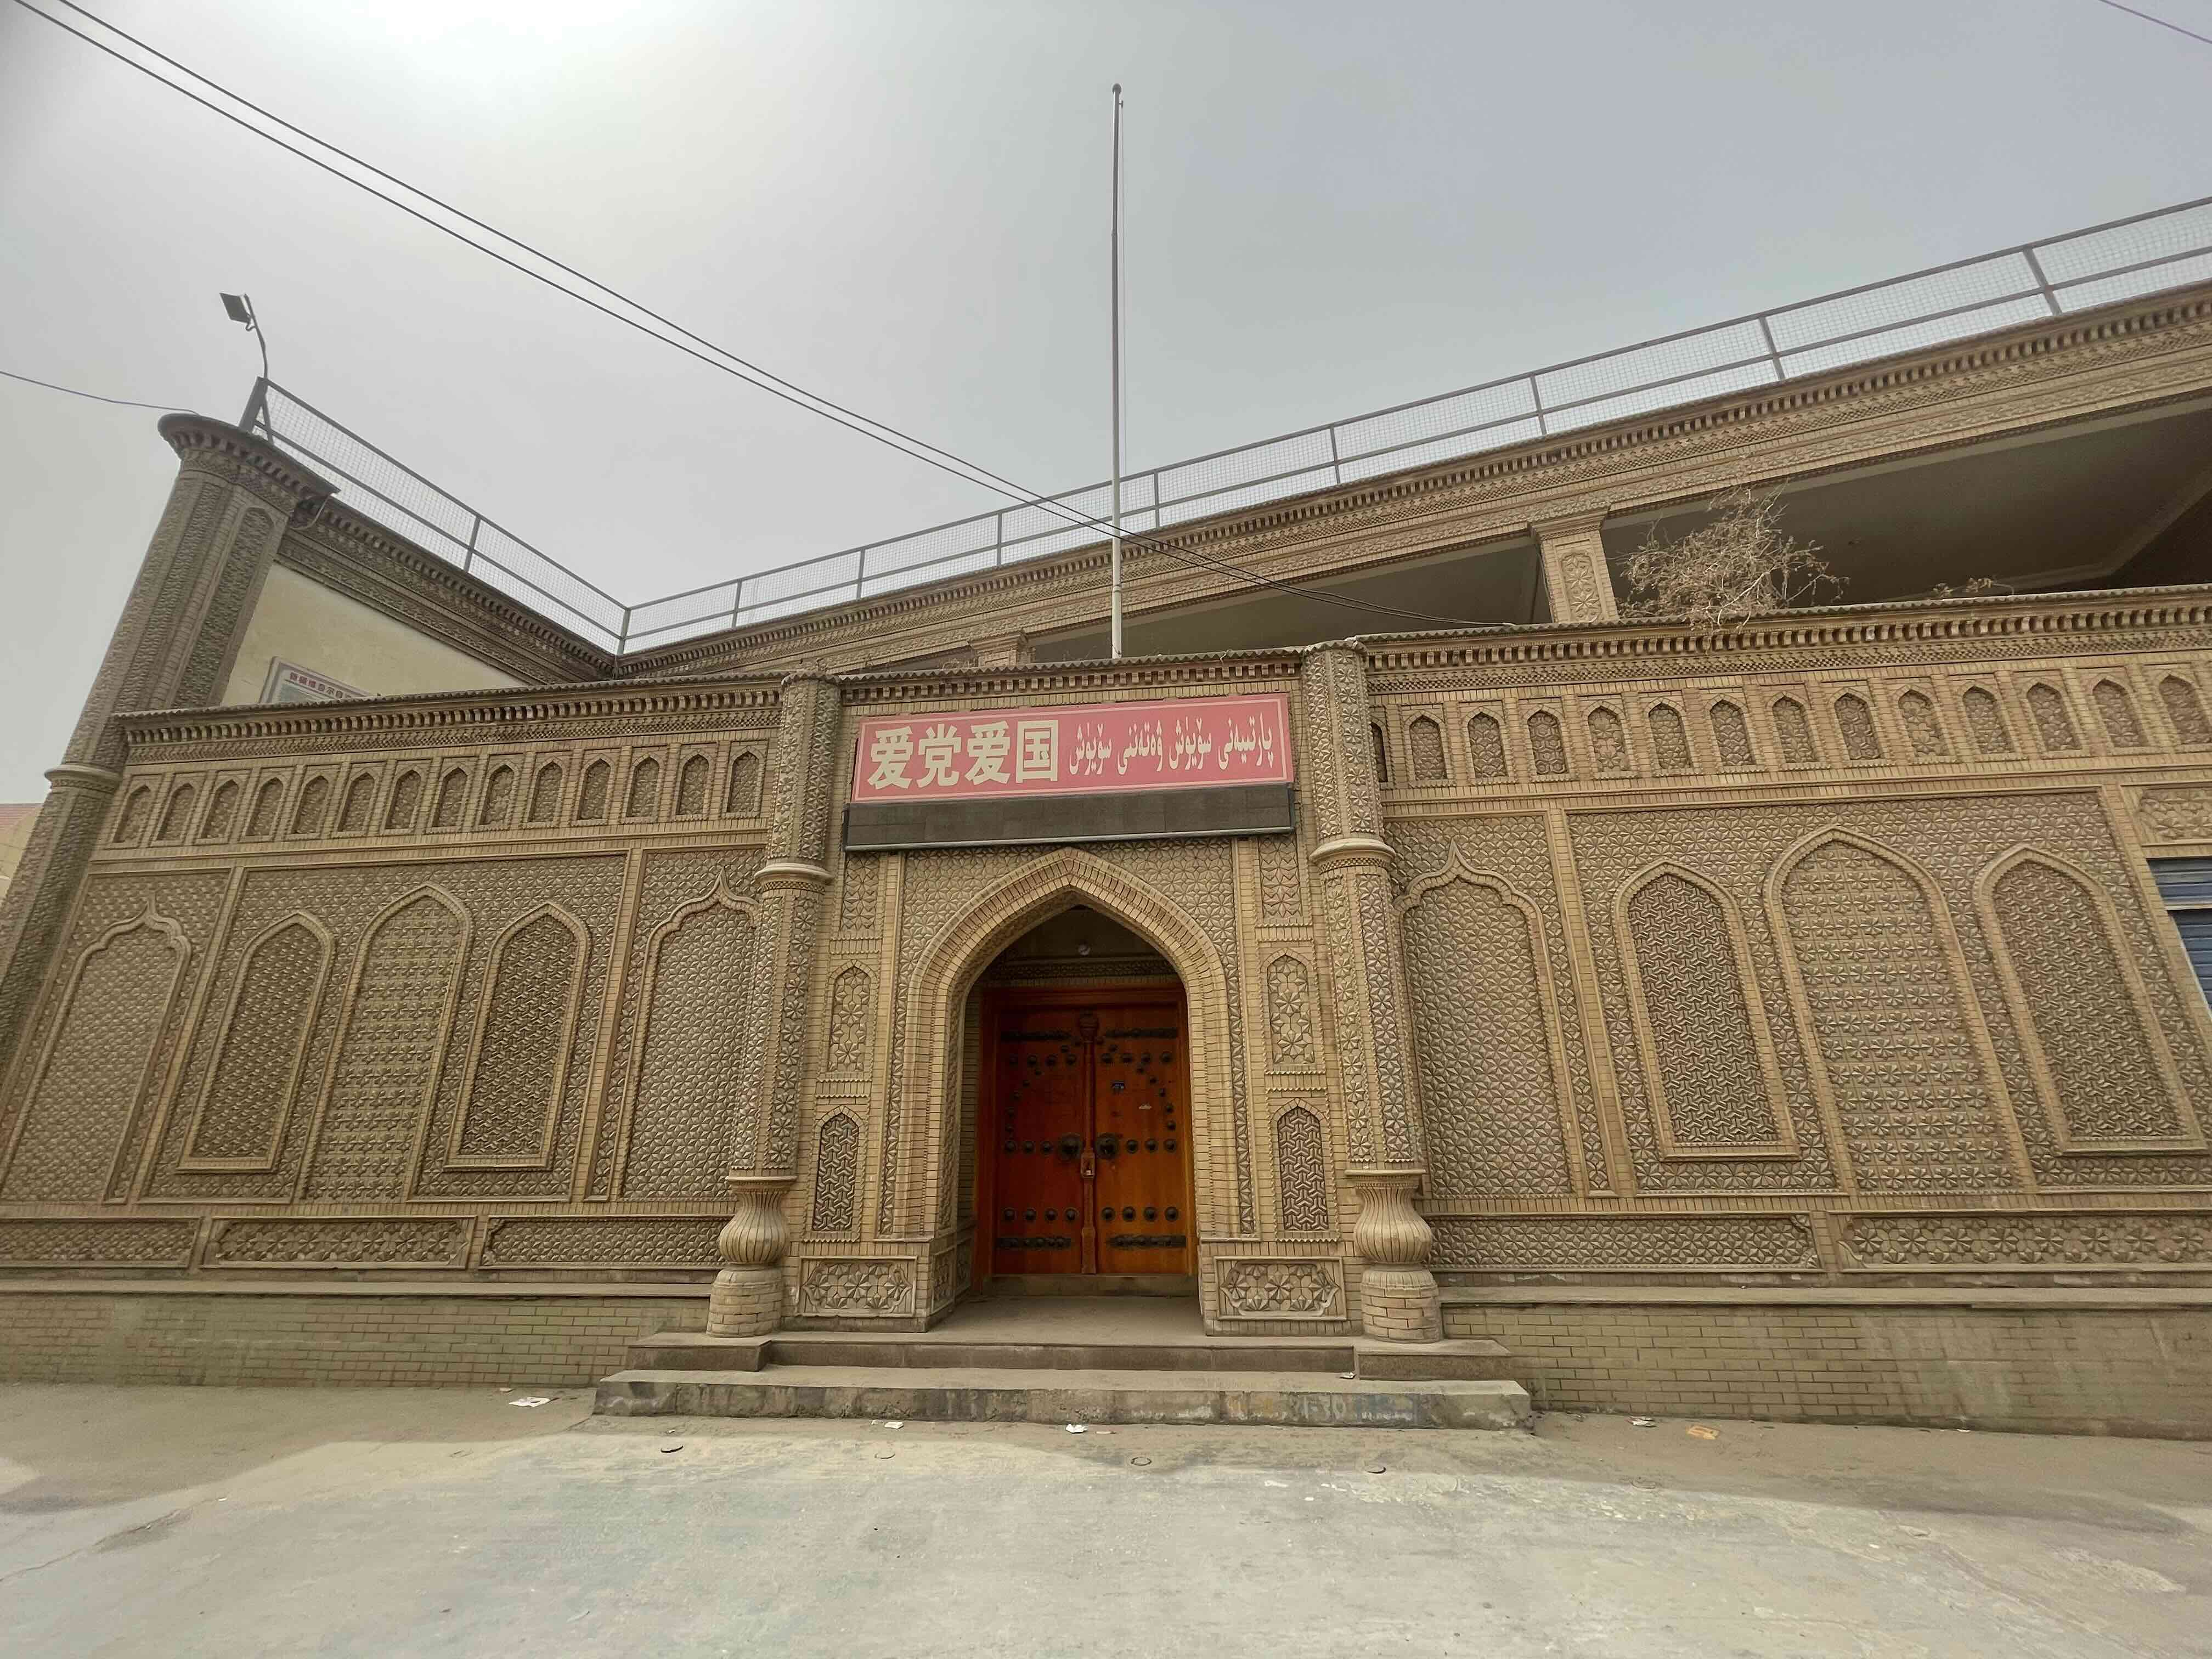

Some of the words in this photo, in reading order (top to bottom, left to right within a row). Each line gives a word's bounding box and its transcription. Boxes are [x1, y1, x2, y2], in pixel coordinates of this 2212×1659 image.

[867, 720, 1058, 789] 爱党爱国
[1070, 722, 1111, 776] سۆيۈش
[1118, 720, 1163, 775] ۋەتەننى
[1169, 716, 1212, 770] سۆيۈش
[1218, 712, 1273, 770] پارتىيەنى
